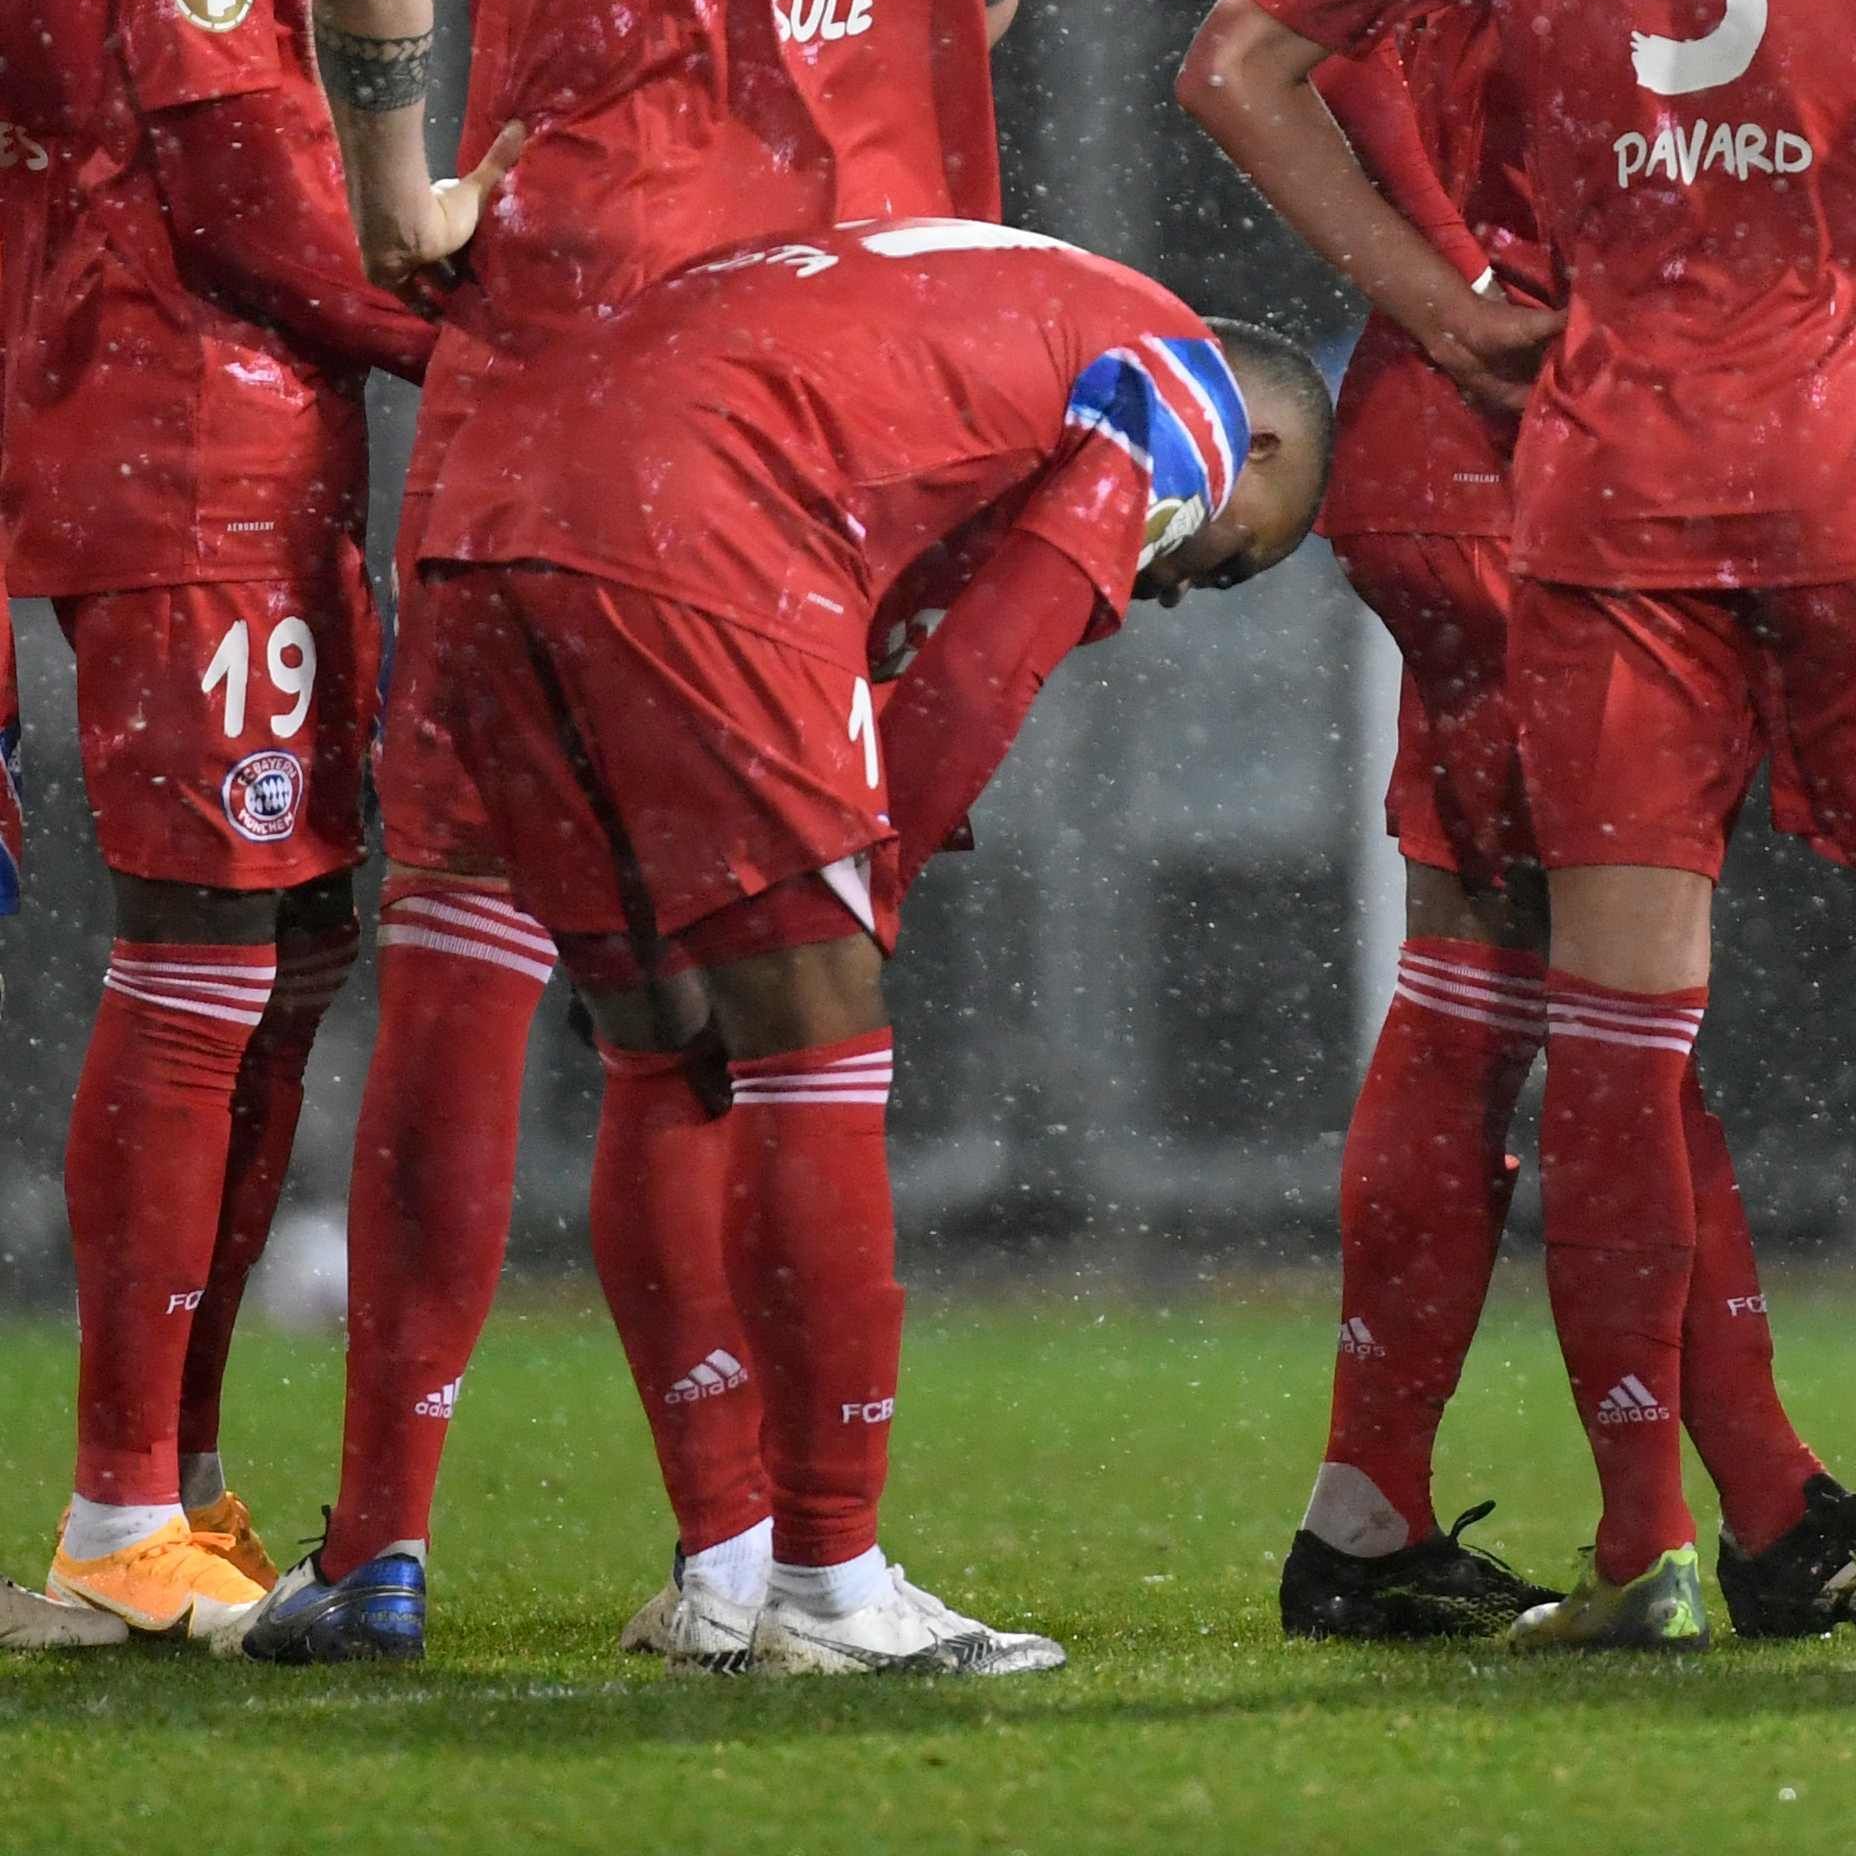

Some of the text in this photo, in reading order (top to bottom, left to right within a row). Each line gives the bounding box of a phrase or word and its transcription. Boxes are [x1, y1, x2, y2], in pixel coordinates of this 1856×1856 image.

[1612, 118, 1814, 190] PAVARD
[201, 615, 318, 739] 19
[252, 758, 298, 779] BAYERN
[664, 1368, 748, 1404] adidas
[1598, 1405, 1670, 1424] adidas
